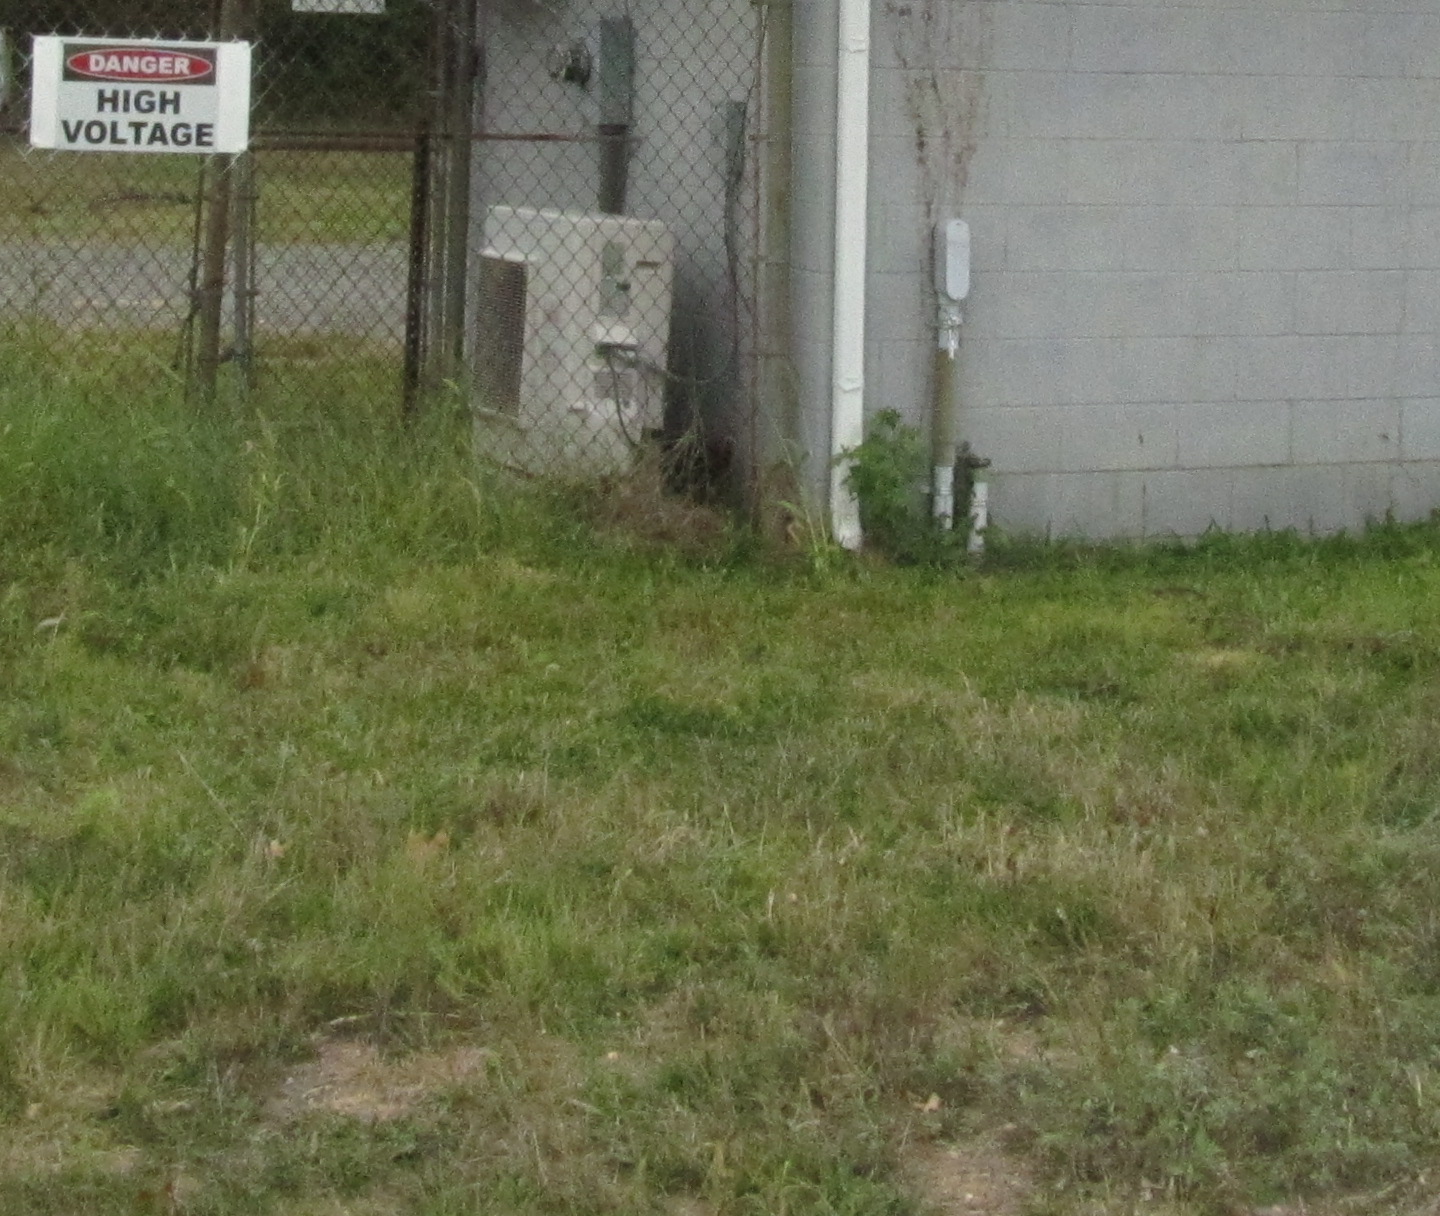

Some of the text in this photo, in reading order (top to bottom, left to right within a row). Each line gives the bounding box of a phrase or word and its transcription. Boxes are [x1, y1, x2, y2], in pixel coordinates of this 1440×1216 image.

[89, 54, 190, 76] DANGER
[97, 89, 180, 114] HIGH
[62, 120, 214, 146] VOLTAGE
